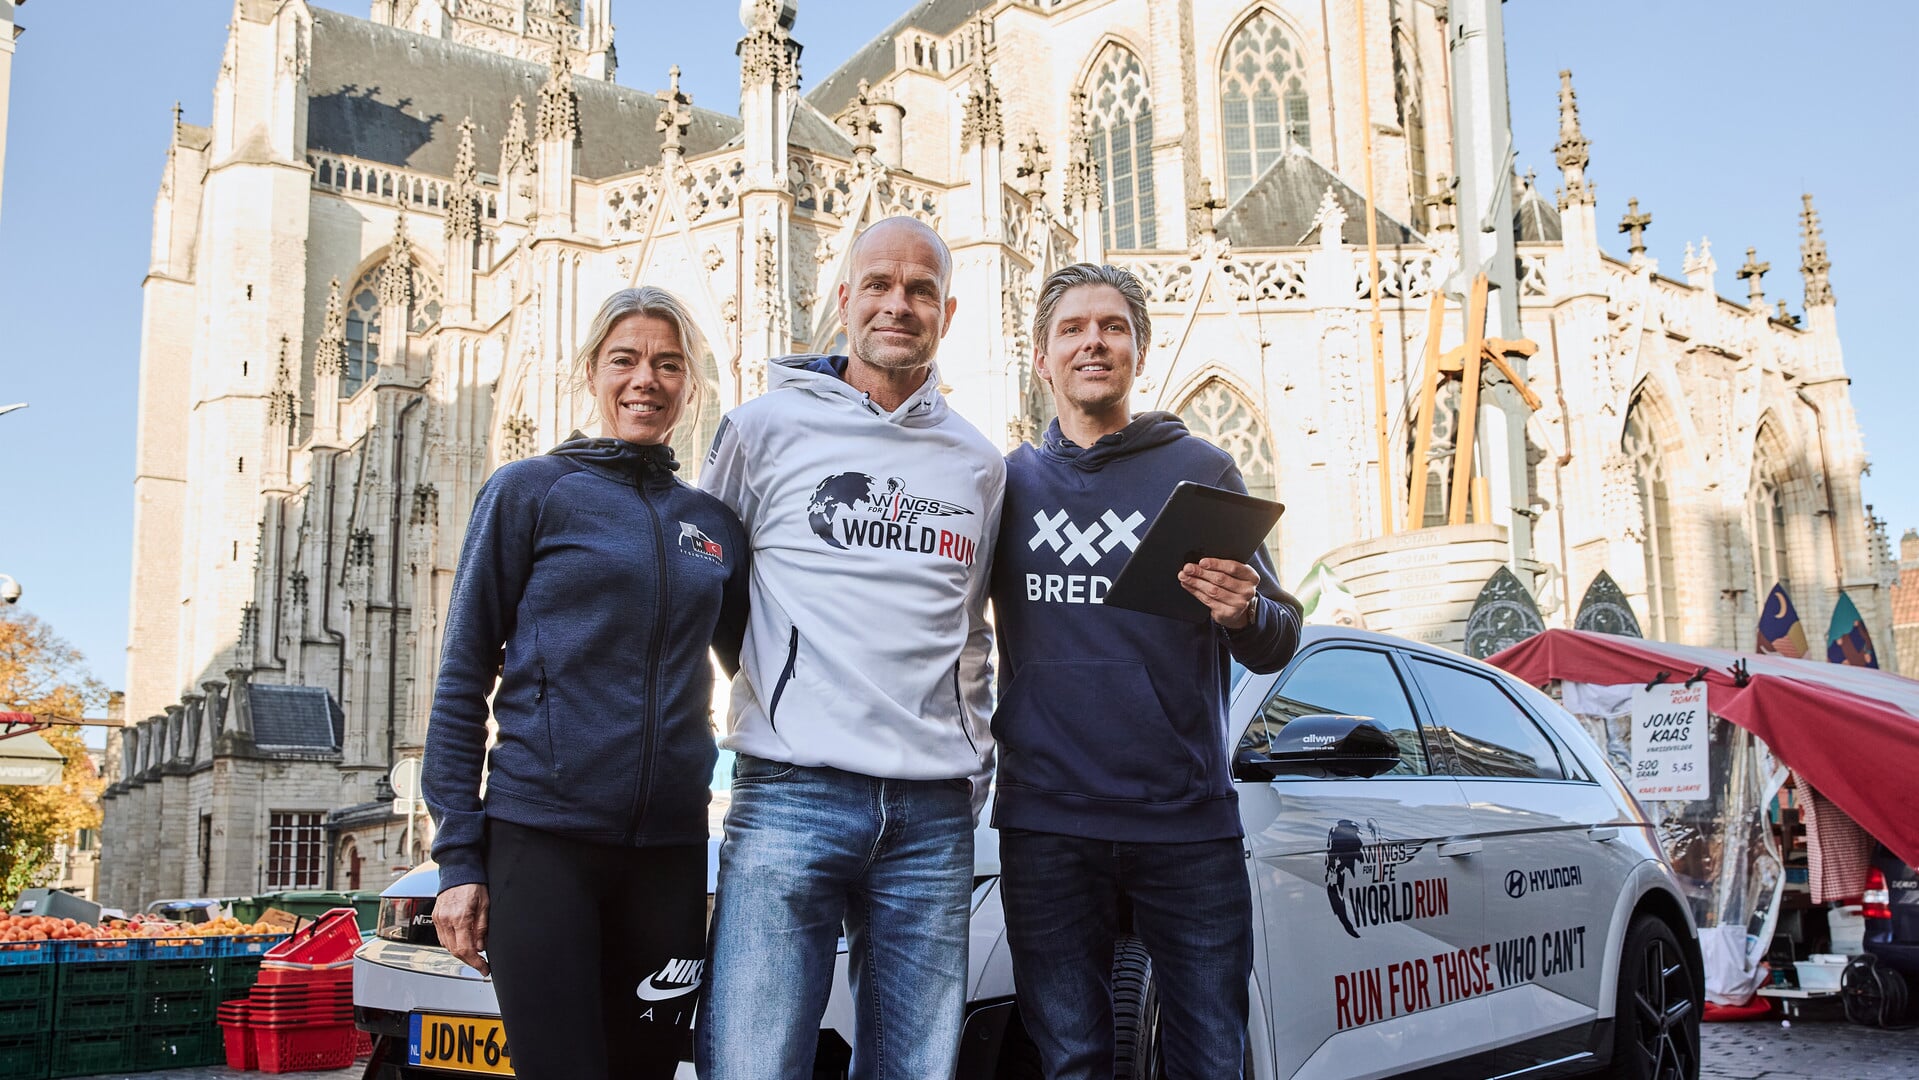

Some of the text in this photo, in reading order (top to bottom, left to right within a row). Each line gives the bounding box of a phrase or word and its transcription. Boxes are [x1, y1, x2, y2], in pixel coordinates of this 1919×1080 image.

[872, 493, 940, 514] WINGS
[881, 508, 923, 525] LIFE
[1026, 573, 1113, 604] BRED
[1643, 710, 1696, 728] JONGE
[1302, 734, 1336, 744] allwyn
[1649, 727, 1690, 743] KAAS
[1636, 759, 1694, 774] 500 5,45
[1636, 770, 1659, 778] GRAM
[1362, 843, 1406, 863] WINGS
[1362, 863, 1396, 883] FOR LIFE
[1529, 865, 1583, 892] HYUNDAI
[1334, 925, 1586, 1030] RUN FOR THOSE WHO CAN'T
[410, 1044, 420, 1057] NL
